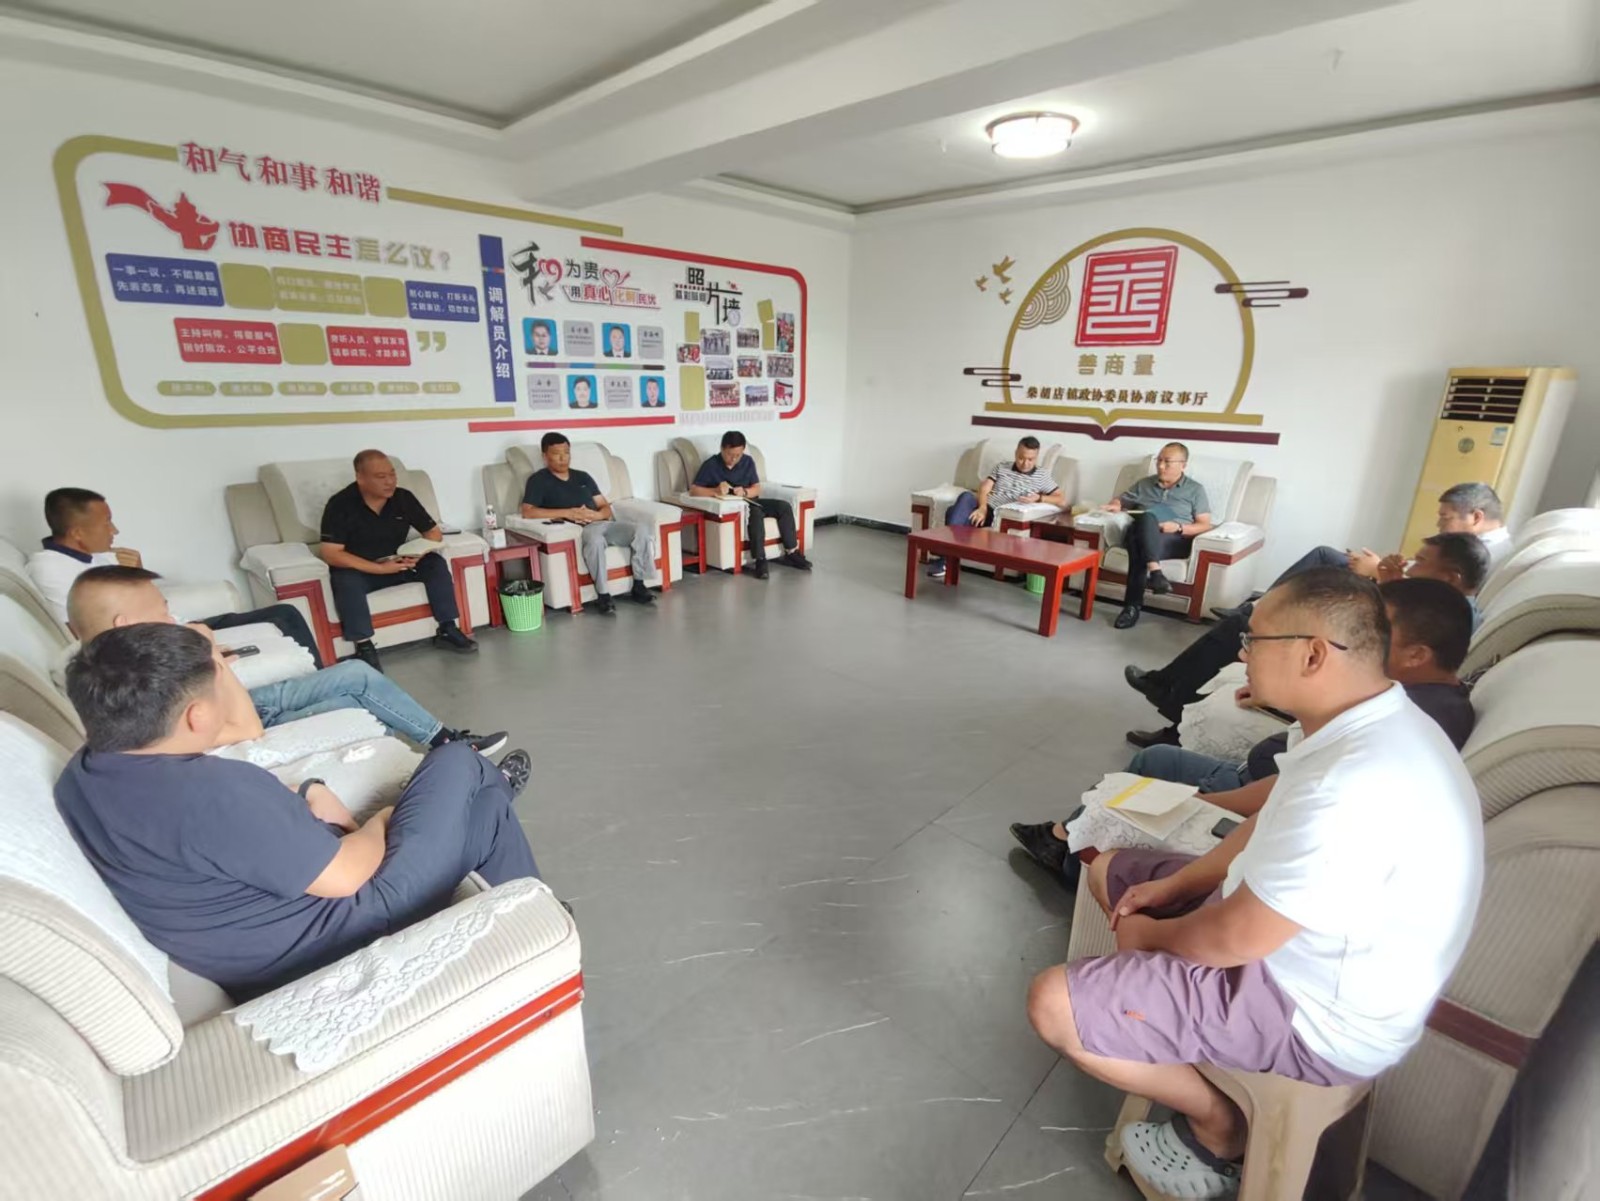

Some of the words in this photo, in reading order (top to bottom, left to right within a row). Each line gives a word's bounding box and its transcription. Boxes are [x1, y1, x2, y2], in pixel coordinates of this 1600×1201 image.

[182, 142, 381, 203] 和气和事和谐
[488, 286, 511, 378] 调解员介绍
[1077, 353, 1156, 377] 善商量
[1027, 386, 1208, 406] 柴胡店镇政协委员协商议事厅
